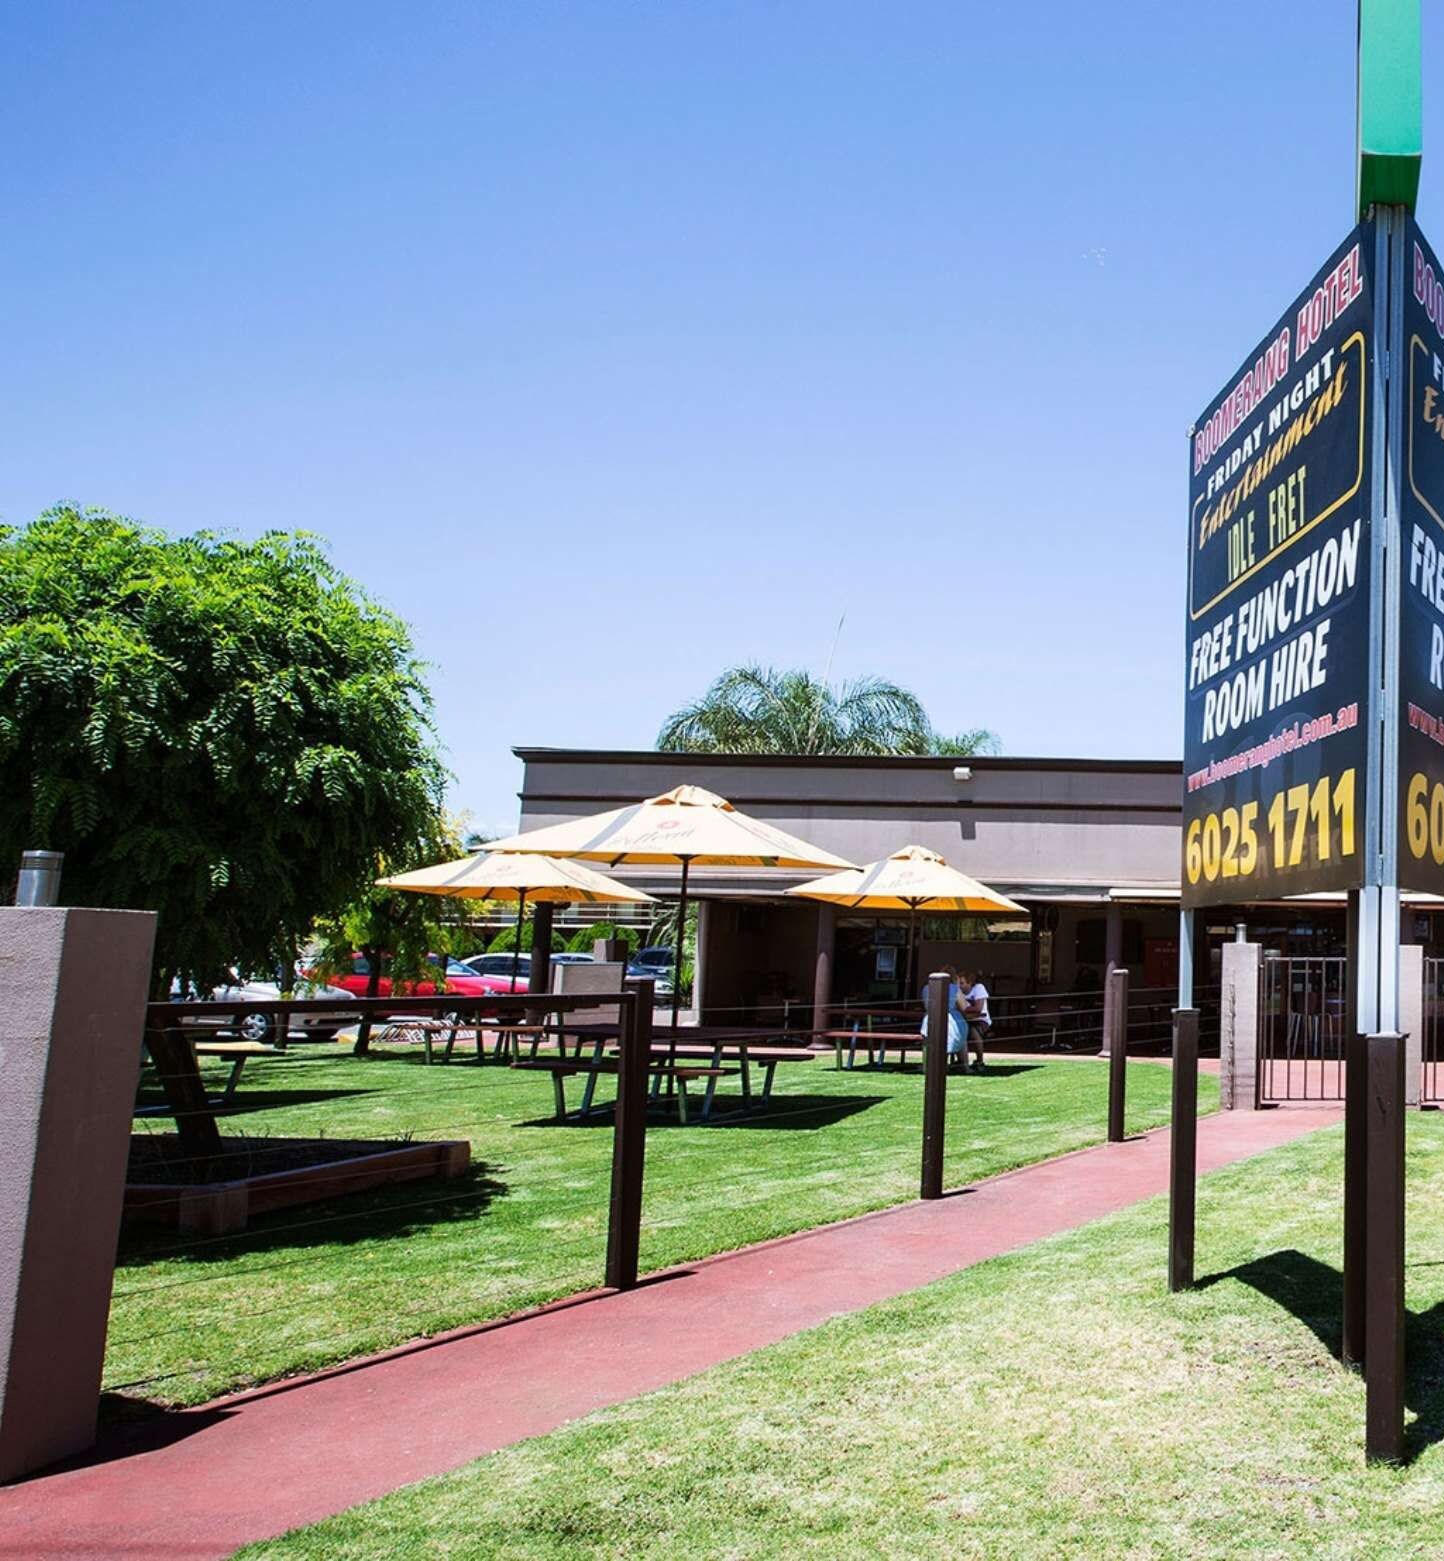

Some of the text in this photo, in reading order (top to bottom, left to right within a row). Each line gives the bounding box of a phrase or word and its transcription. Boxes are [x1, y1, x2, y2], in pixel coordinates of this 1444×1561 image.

[1194, 243, 1363, 476] BOOMERANG HOTEL
[1207, 348, 1335, 500] FRIDAY NIGHT
[1199, 361, 1348, 550] Entertainment
[1227, 464, 1307, 583] IDLE FRET
[1190, 518, 1361, 691] FREE FUNCTION
[1187, 702, 1359, 793] www.boomeranghotel.com.au
[1202, 618, 1331, 744] ROOM HIRE
[1186, 801, 1259, 884] 6025
[1268, 768, 1356, 869] 1711
